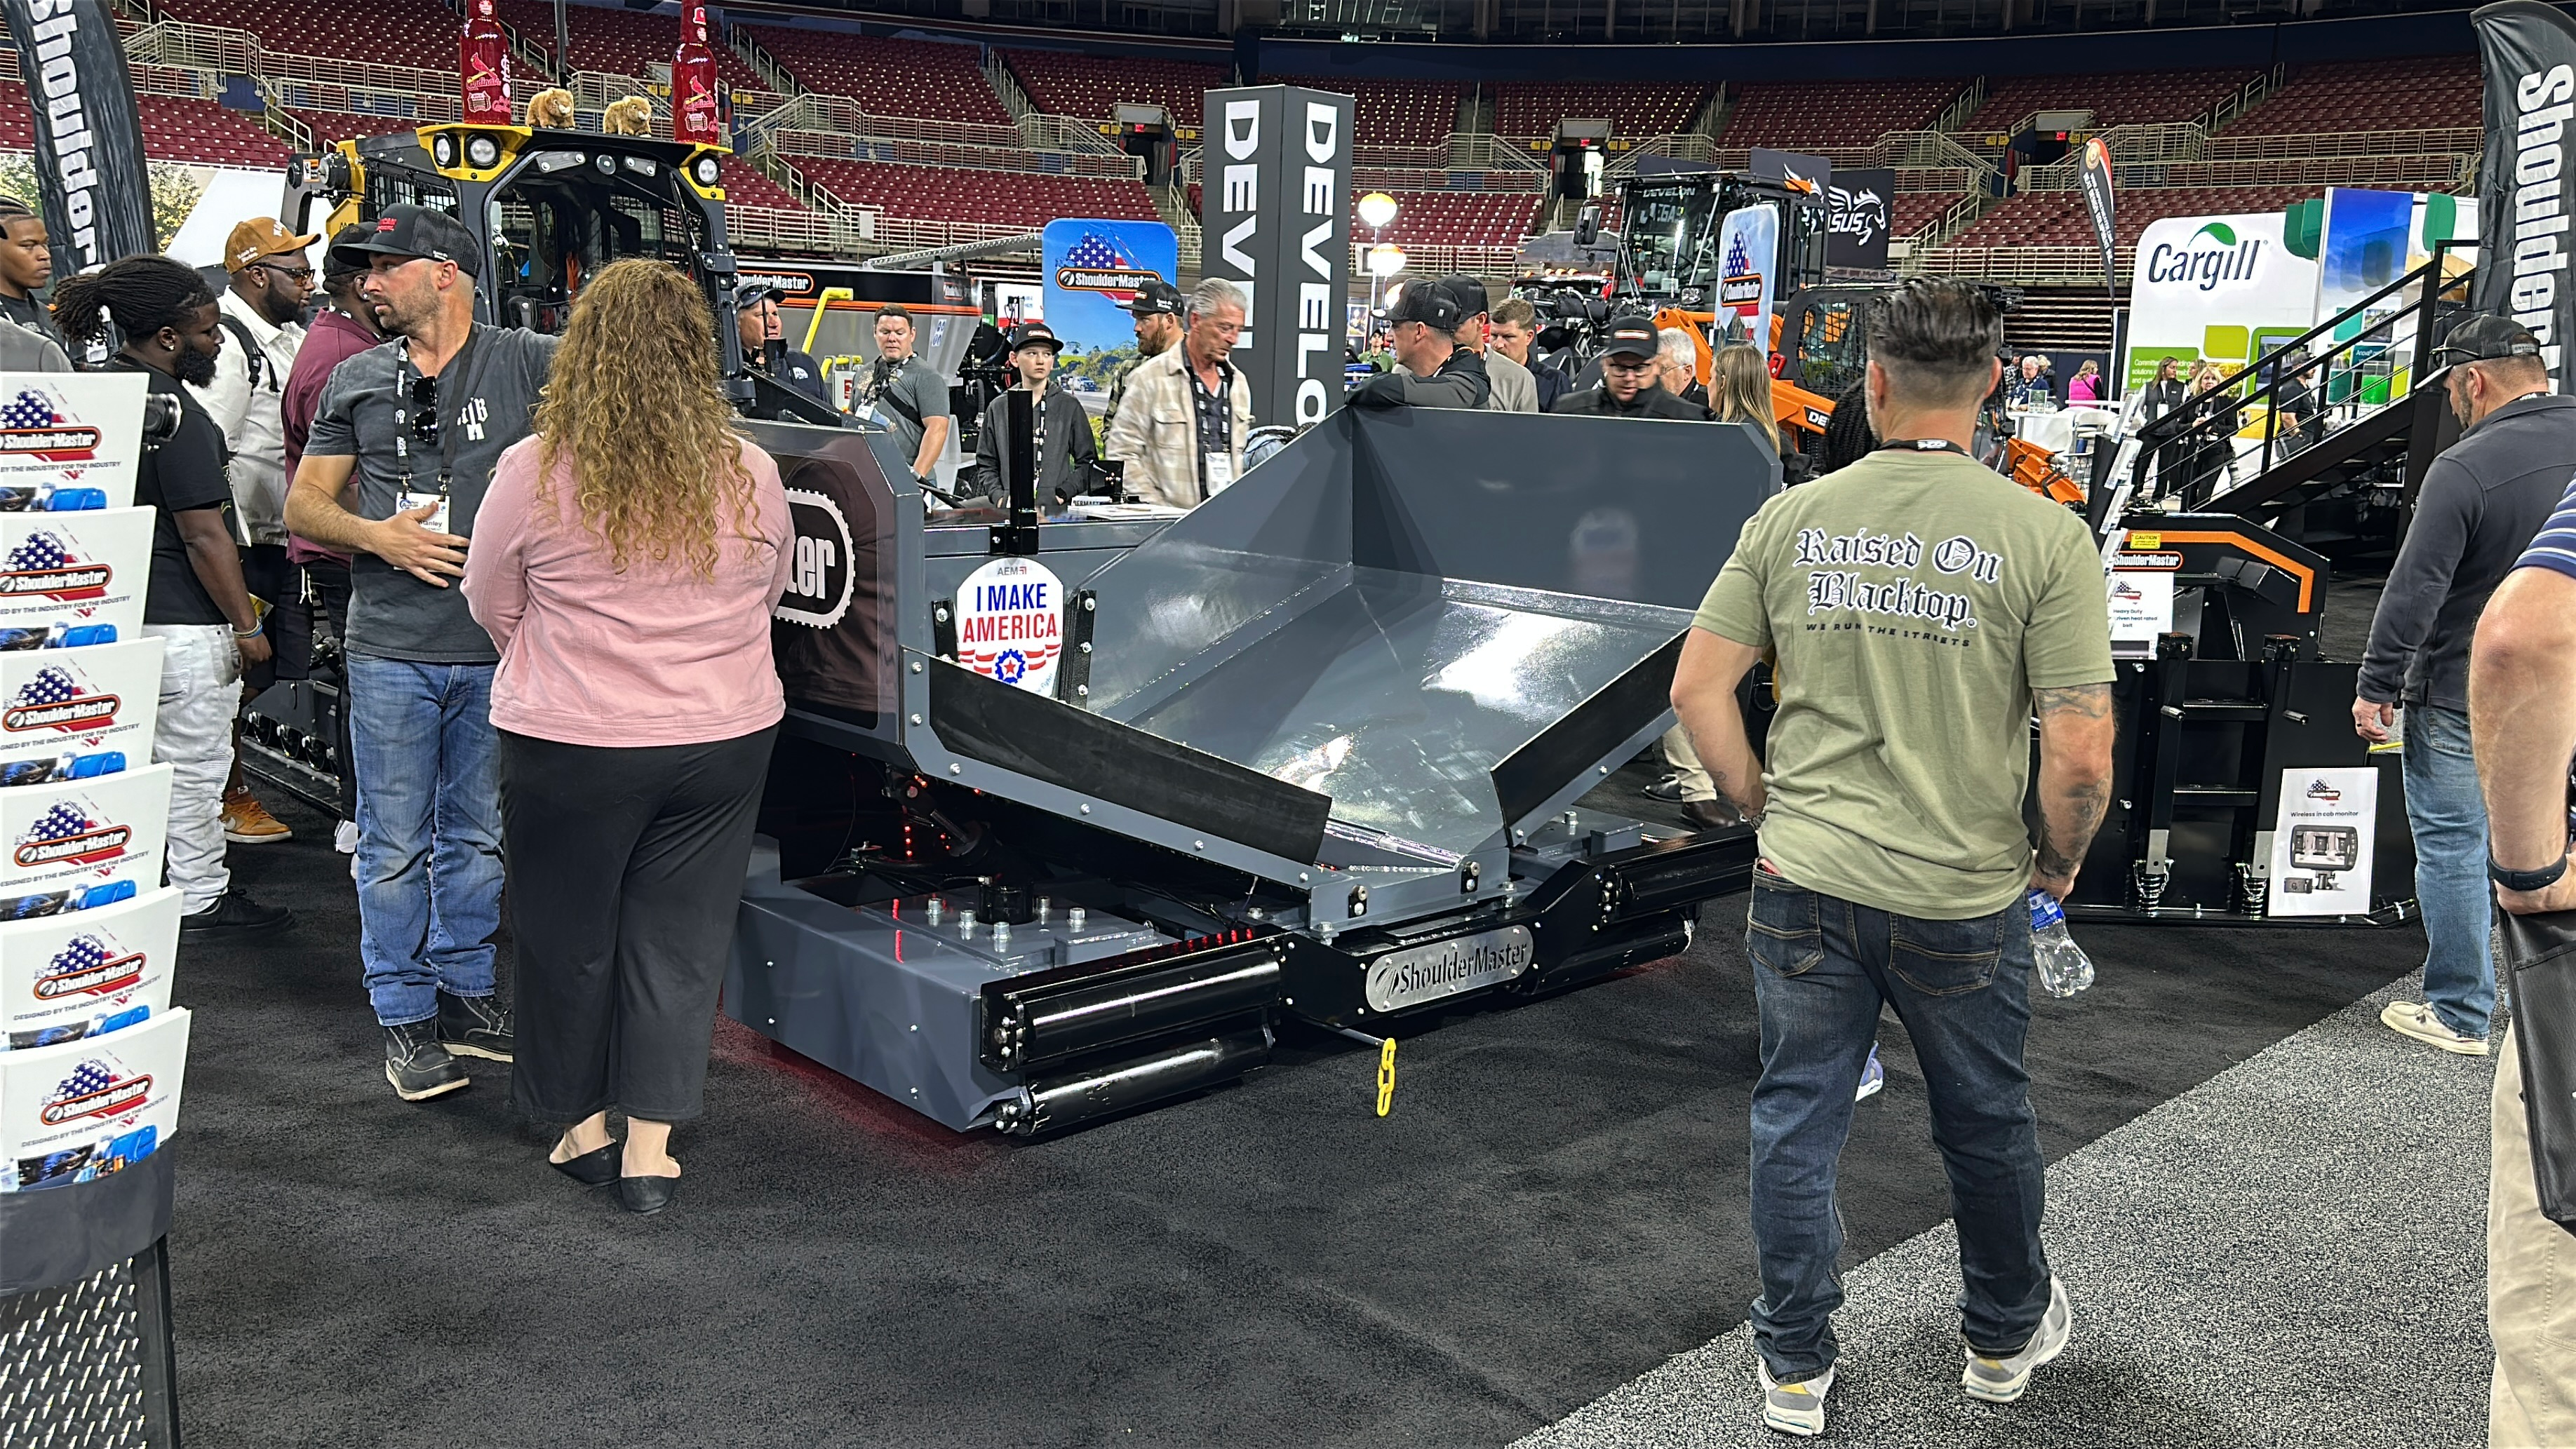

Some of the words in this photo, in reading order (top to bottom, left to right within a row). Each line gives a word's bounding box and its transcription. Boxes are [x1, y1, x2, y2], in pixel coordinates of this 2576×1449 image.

[1642, 187, 1696, 197] DEVELON
[2148, 240, 2260, 291] Cargill
[1808, 412, 1830, 426] DE
[4, 433, 95, 449] ShoulderMaster
[1792, 527, 1924, 570] Raised
[1932, 535, 2003, 584] On
[2114, 554, 2179, 566] ShoulderMaster
[15, 572, 107, 591] ShoulderMaster
[997, 567, 1018, 576] AEM
[38, 604, 72, 612] INDUSTRY
[101, 595, 131, 605] INDUSTRY
[977, 586, 981, 612] I
[988, 583, 1047, 612] MAKE
[962, 613, 1057, 643] AMERICA
[1868, 626, 1896, 635] THE
[1904, 631, 1970, 647] STREETS
[26, 701, 115, 724] ShoulderMaster
[46, 734, 80, 743] INDUSTRY
[109, 723, 140, 734] INDUSTRY
[38, 832, 126, 860] ShoulderMaster
[59, 865, 93, 877] INDUSTRY
[120, 850, 149, 864] INDUSTRY
[57, 959, 142, 992] ShoulderMaster
[1400, 942, 1527, 994] ShoulderMaster
[13, 1010, 52, 1020] DESIGNED
[79, 995, 111, 1009] INDUSTRY
[136, 974, 161, 990] INDUSTRY
[63, 1081, 149, 1118] ShoulderMaster
[21, 1135, 58, 1147] DESIGNED
[85, 1118, 117, 1132] INDUSTRY
[119, 1112, 130, 1121] FOR
[142, 1095, 169, 1111] INDUSTRY
